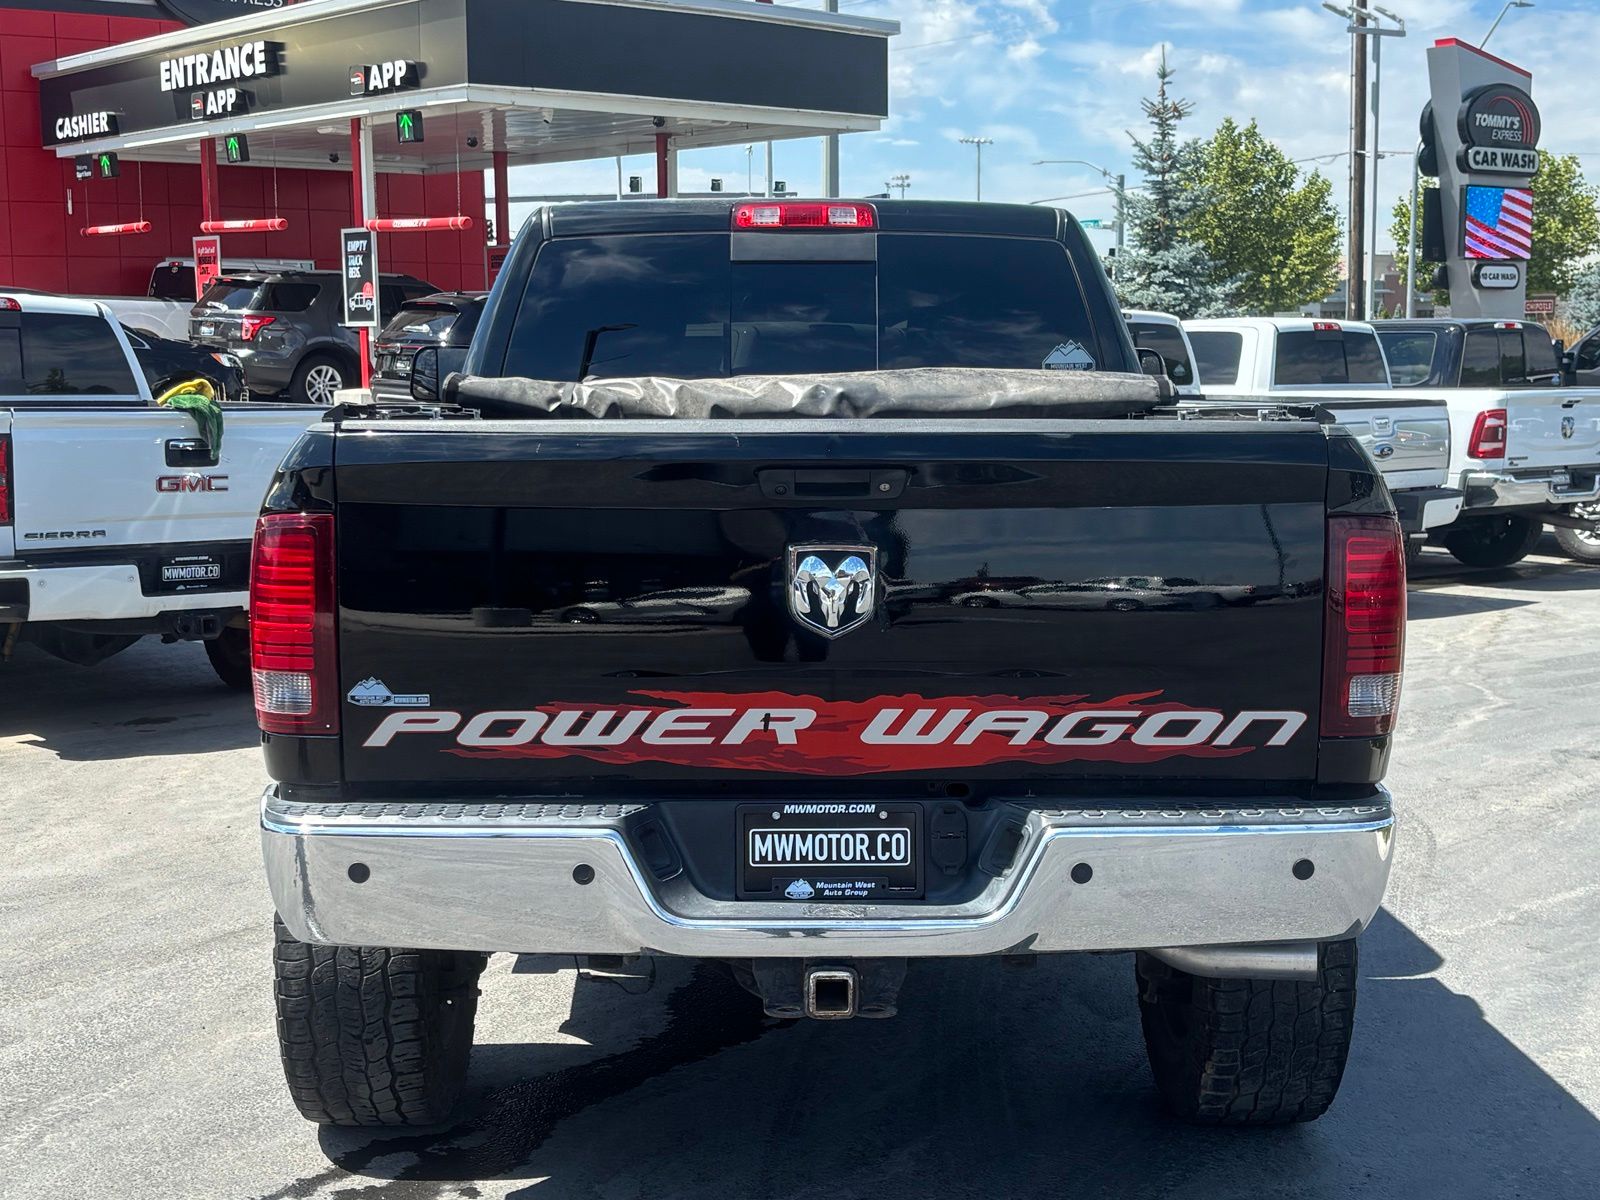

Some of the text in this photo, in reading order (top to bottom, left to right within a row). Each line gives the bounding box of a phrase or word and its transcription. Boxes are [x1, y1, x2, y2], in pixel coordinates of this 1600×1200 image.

[160, 41, 266, 92] ENTRANCE
[369, 60, 406, 91] APP
[206, 88, 236, 115] APP
[56, 112, 109, 139] CASHIER
[1475, 113, 1520, 129] TOMMY'S
[1491, 129, 1522, 141] EXPRESS
[1473, 150, 1536, 169] CAR WASH
[347, 240, 367, 251] EMPTY
[1489, 272, 1500, 280] CAR
[155, 475, 229, 493] GMC
[24, 529, 107, 541] SIERRA
[164, 566, 219, 579] MWMOTOR.CO
[362, 708, 1307, 747] POWER WAGON
[783, 804, 876, 814] MWMOTOR.COM
[754, 833, 906, 862] MWMOTOR.CO
[855, 881, 876, 889] West
[844, 890, 868, 898] Group
